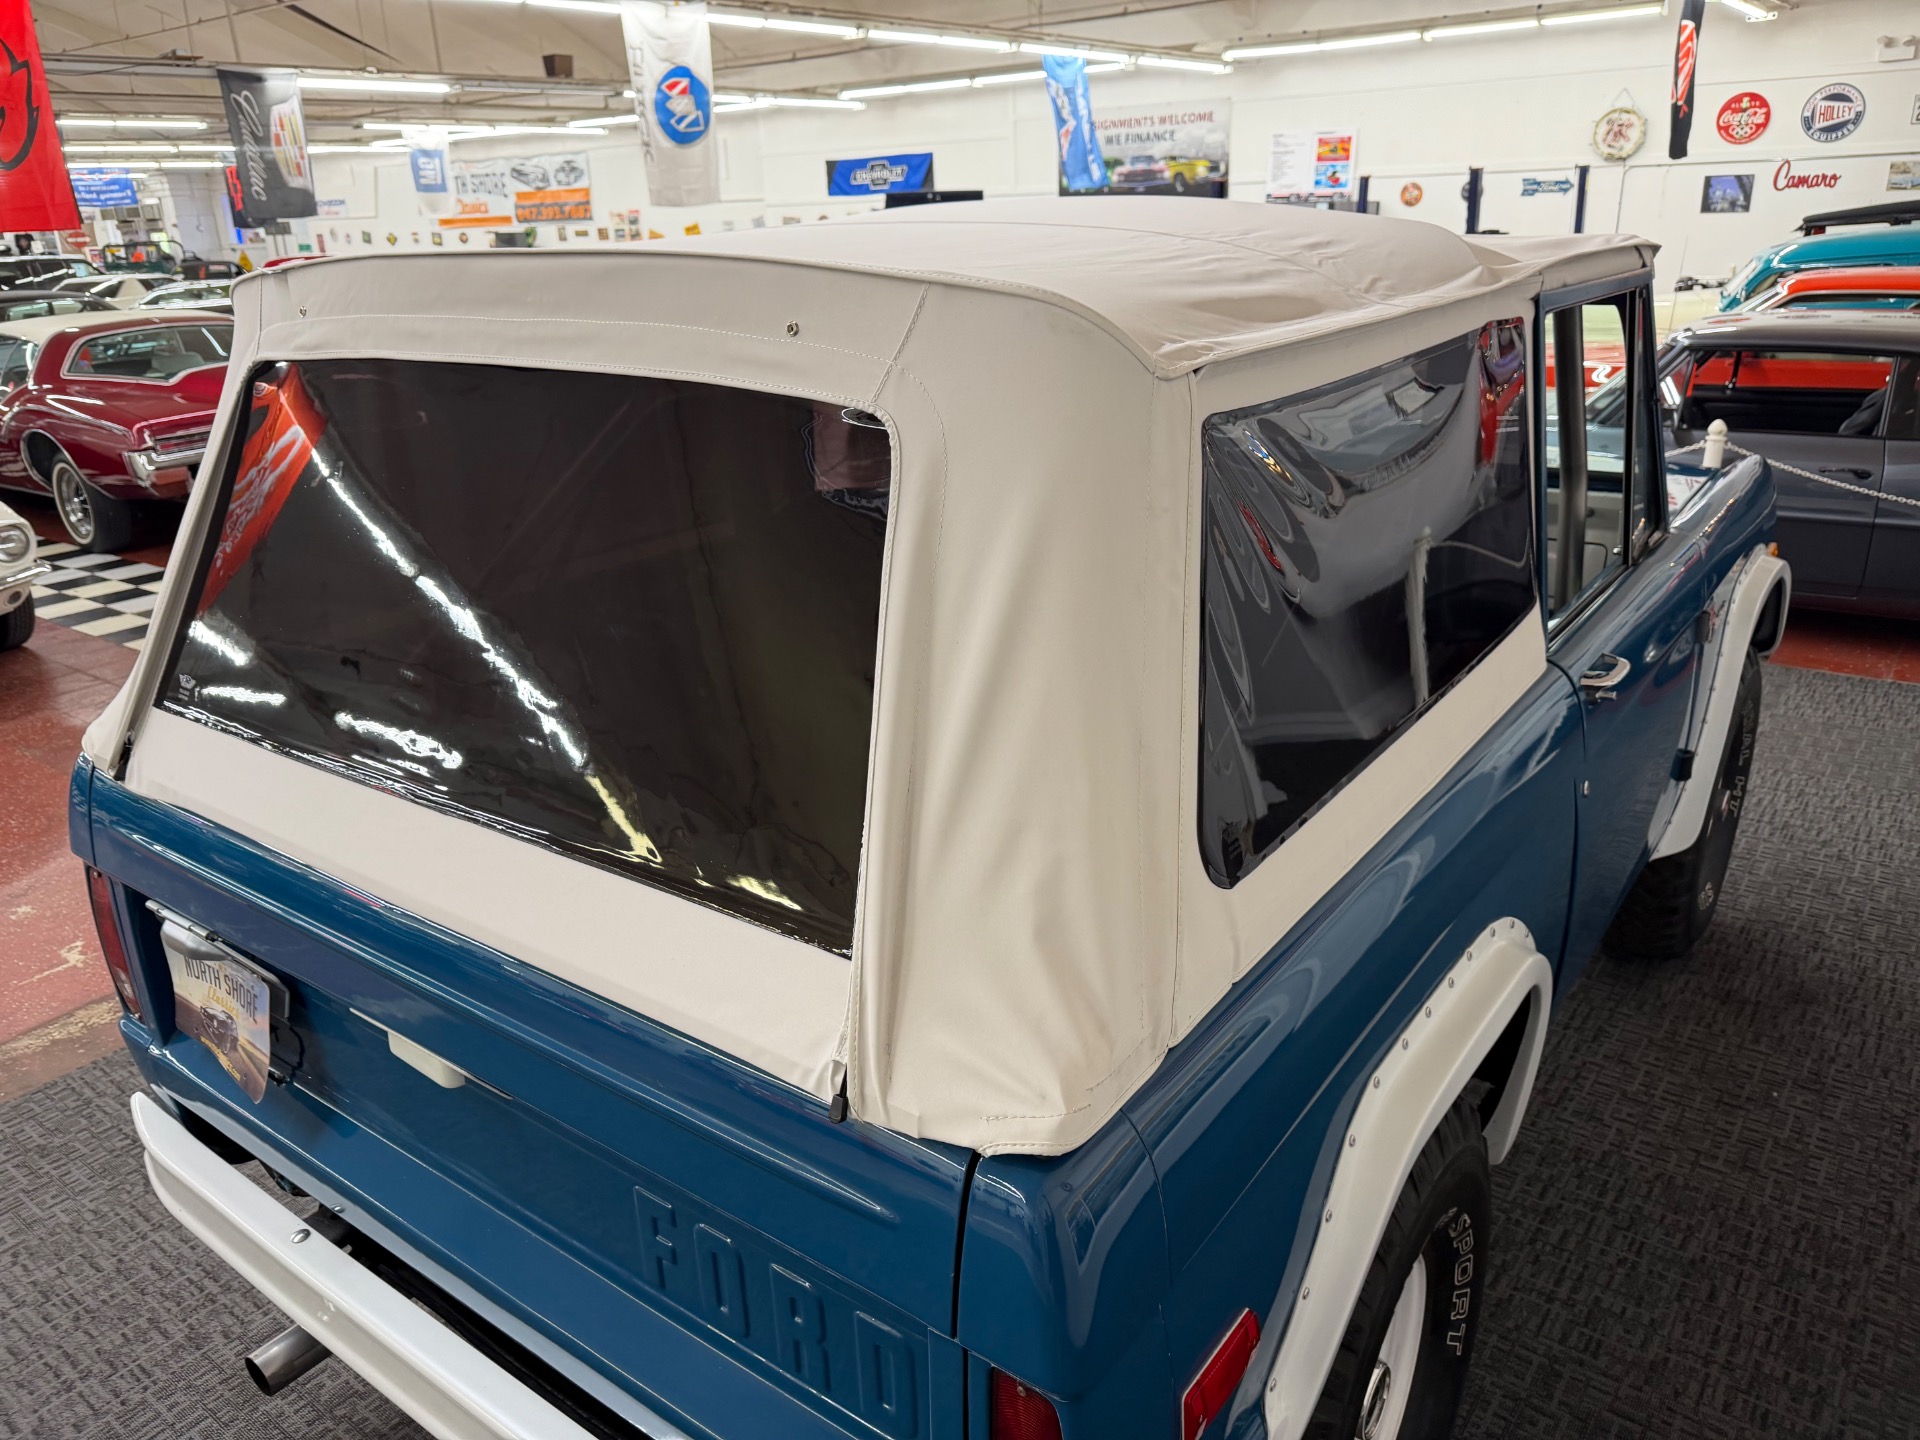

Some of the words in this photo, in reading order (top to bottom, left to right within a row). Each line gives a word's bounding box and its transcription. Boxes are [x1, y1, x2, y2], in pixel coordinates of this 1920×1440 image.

[1819, 86, 1863, 108] PERFORMANCE
[1157, 111, 1216, 126] WELCOME
[1818, 104, 1853, 124] HOLLEY
[230, 89, 268, 201] Cadillac
[1124, 129, 1177, 145] FINANCE
[1810, 123, 1857, 140] EQUIPPED
[1773, 159, 1841, 191] Camaro
[184, 956, 222, 990] NORTH
[224, 974, 258, 1025] SHORE
[1447, 1212, 1476, 1356] SPORT
[633, 1185, 919, 1440] FORD
